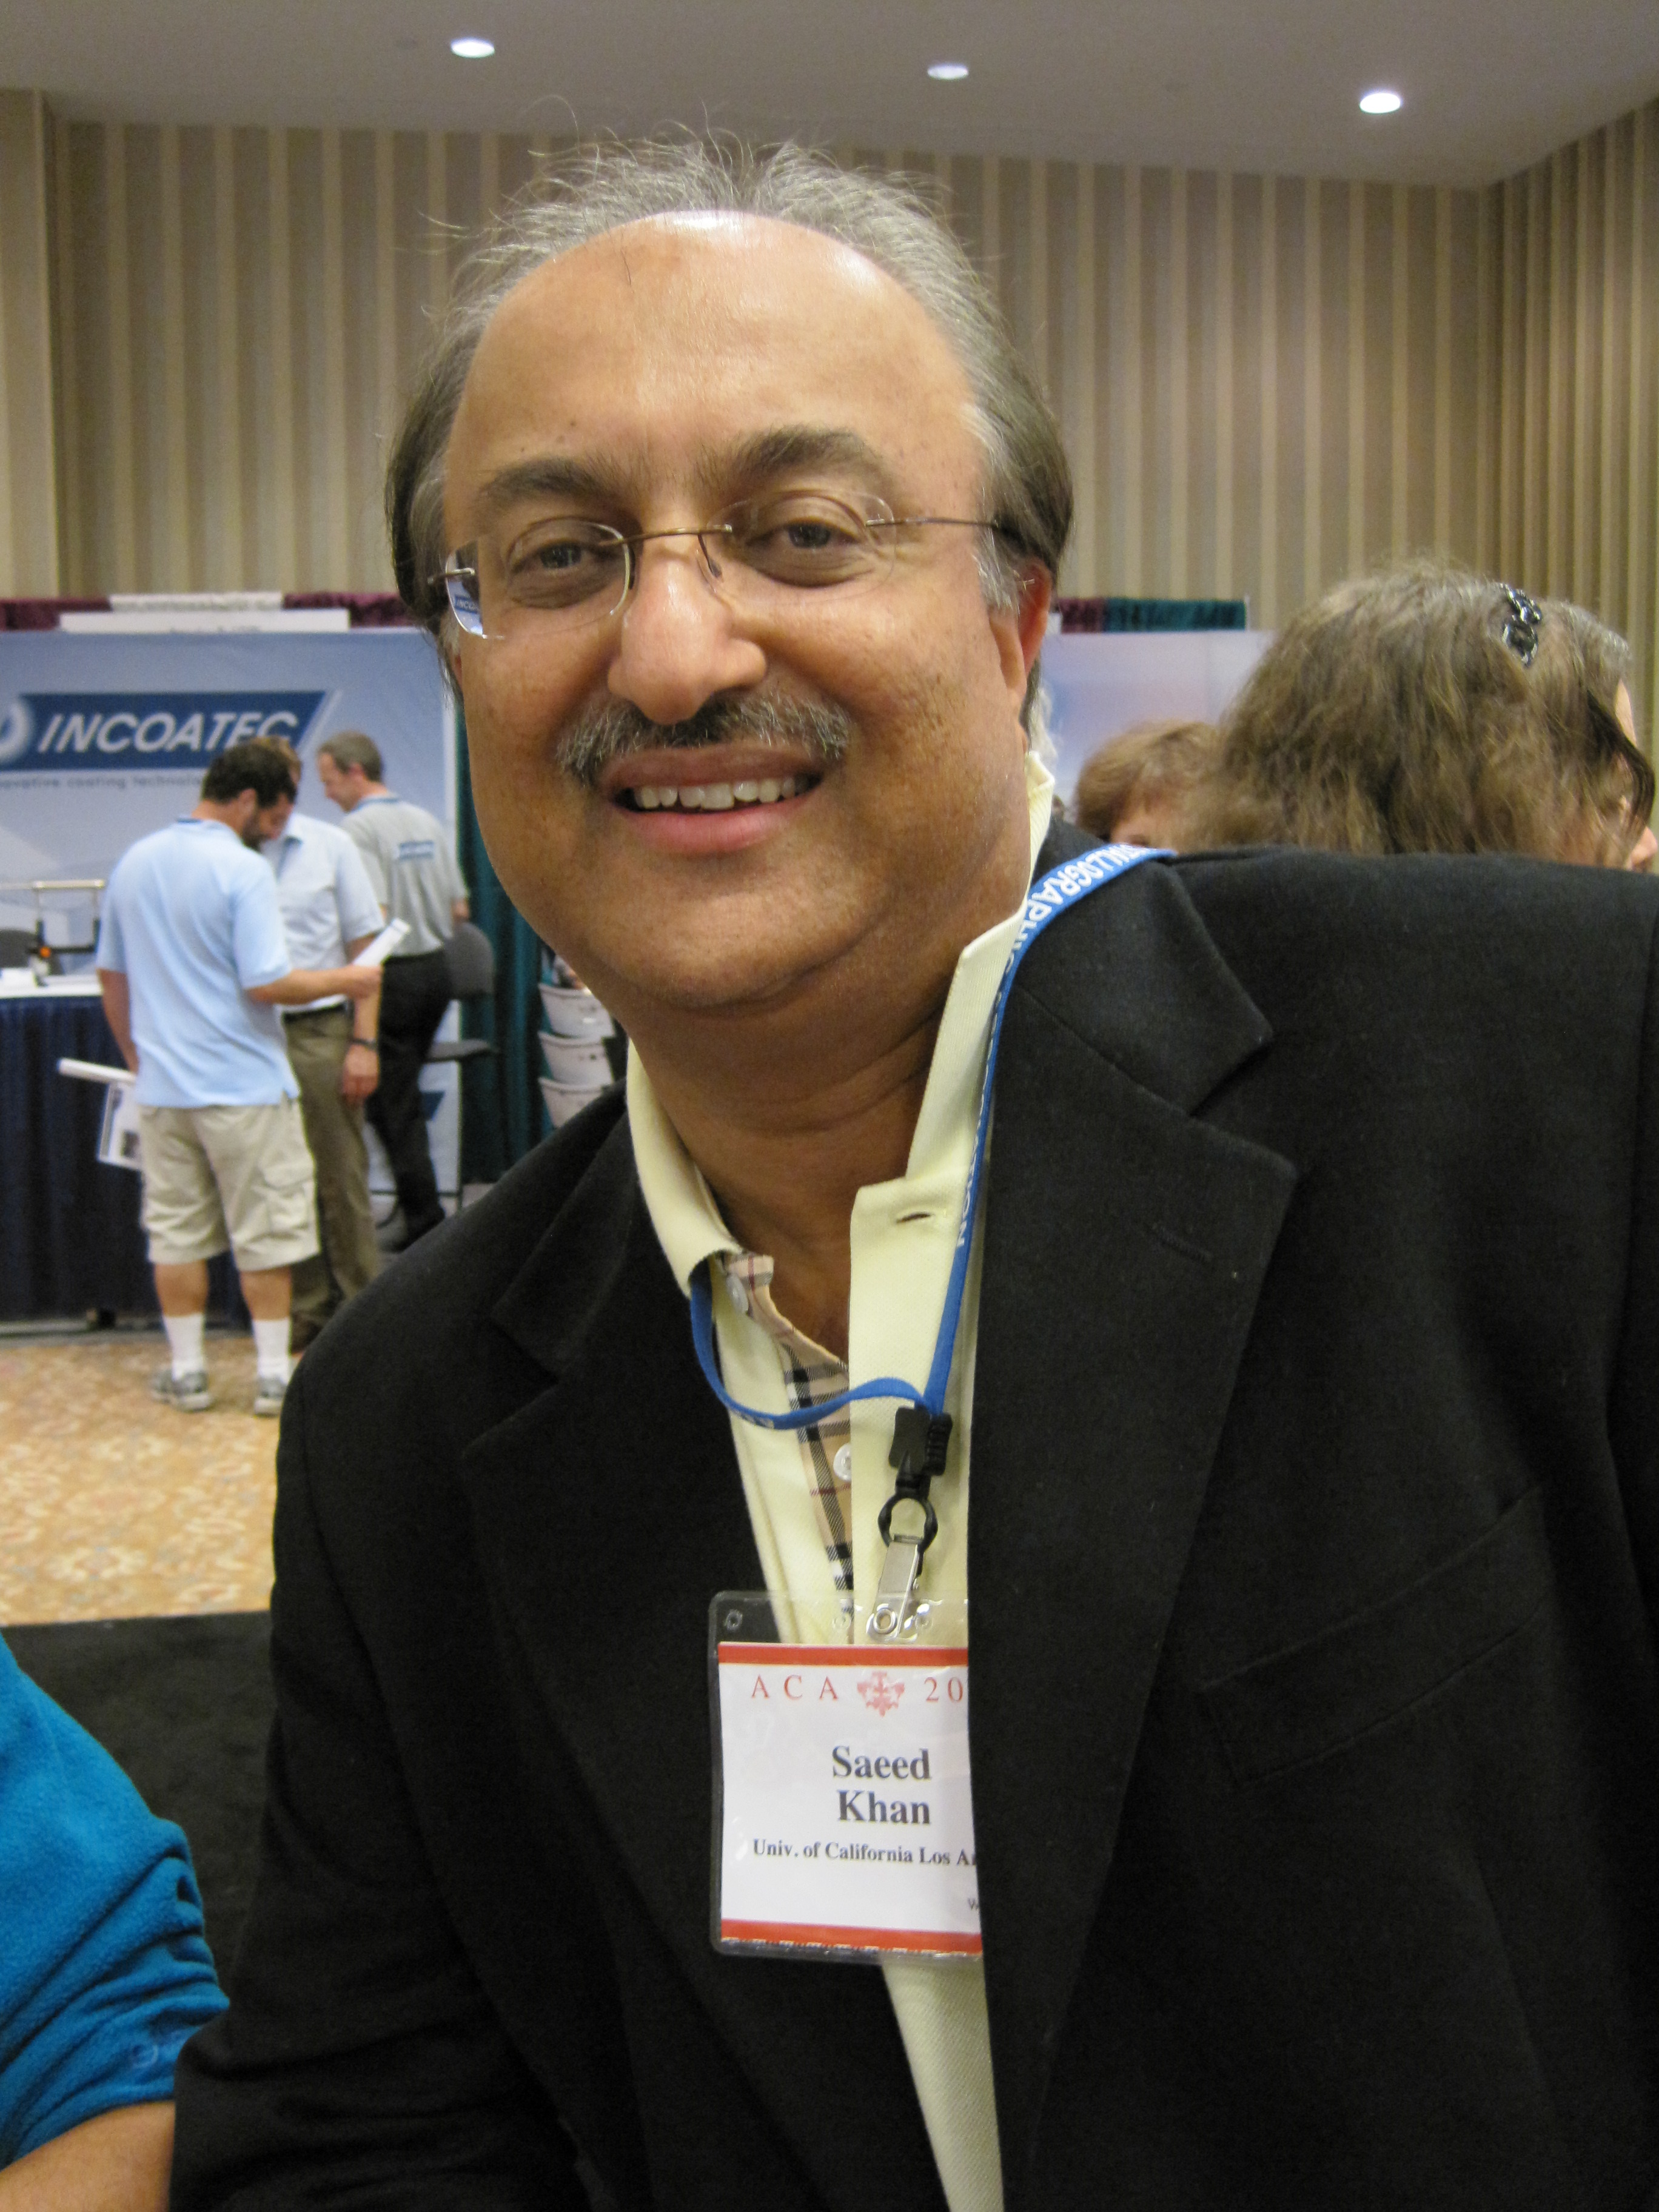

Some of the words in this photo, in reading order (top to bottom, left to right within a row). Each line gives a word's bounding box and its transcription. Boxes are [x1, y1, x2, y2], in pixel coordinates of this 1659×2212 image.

[831, 1744, 932, 1781] Saeed
[836, 1789, 931, 1825] Khan
[752, 1837, 799, 1858] Univ.
[802, 1841, 822, 1859] of
[825, 1841, 913, 1863] California
[919, 1846, 951, 1865] Los
